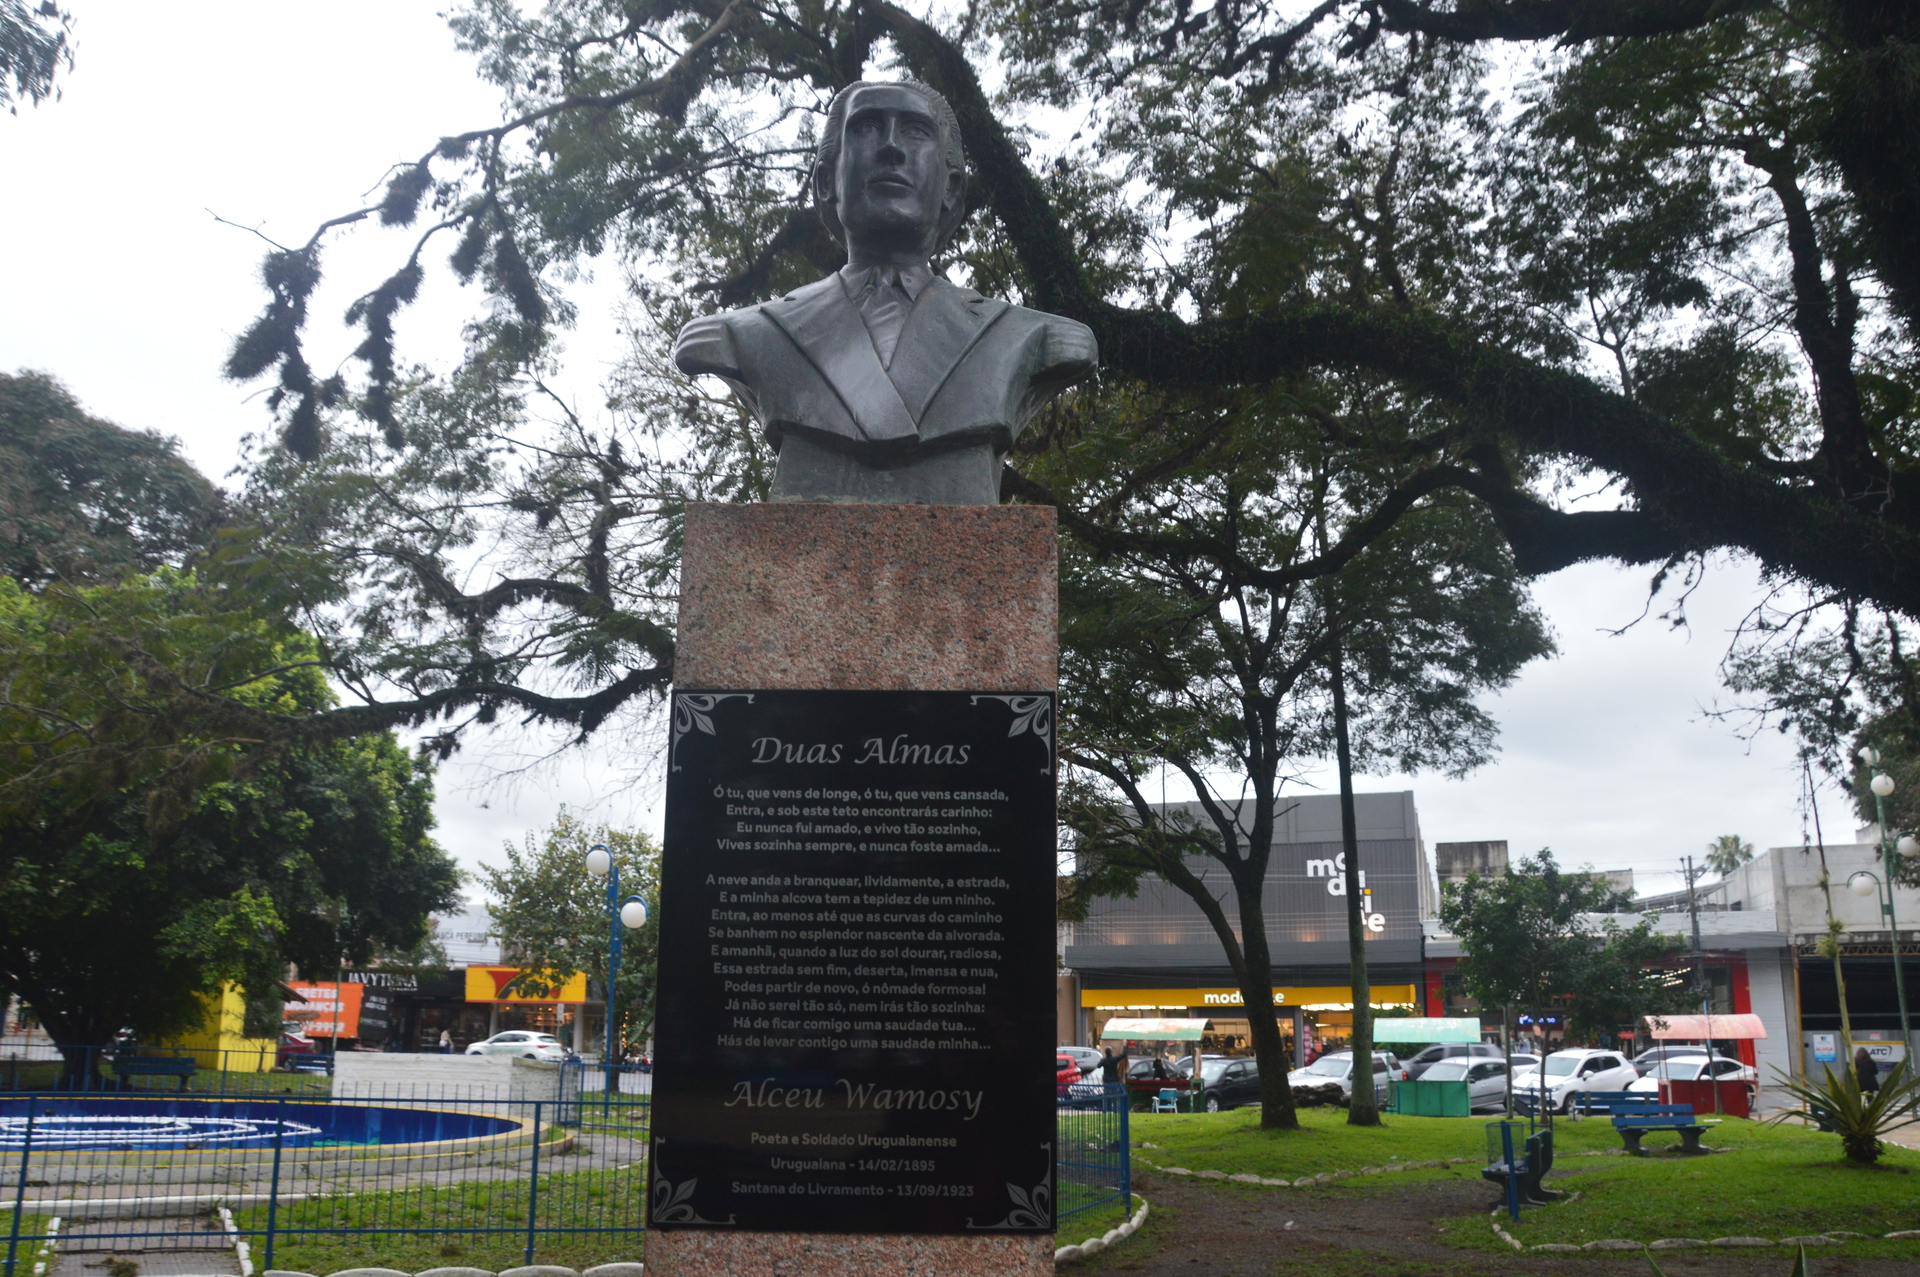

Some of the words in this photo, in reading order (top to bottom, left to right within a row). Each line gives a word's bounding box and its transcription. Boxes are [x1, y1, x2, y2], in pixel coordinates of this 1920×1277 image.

[751, 737, 843, 764] Duas
[853, 733, 971, 765] Almas
[713, 783, 724, 798] Ó
[726, 787, 744, 800] tu,
[746, 789, 770, 801] que
[771, 789, 802, 799] vens
[803, 787, 820, 799] de
[822, 787, 861, 802] longe,
[863, 787, 872, 799] ó
[873, 788, 892, 801] tu,
[894, 790, 919, 802] que
[920, 790, 951, 800] vens
[952, 788, 1009, 802] cansada,
[725, 803, 765, 817] Entra,
[766, 806, 775, 816] e
[776, 804, 800, 816] sob
[801, 805, 830, 816] este
[831, 805, 860, 817] teto
[861, 804, 939, 817] encontrarás
[940, 805, 992, 818] carinho:
[736, 821, 753, 833] Eu
[754, 823, 793, 833] nunca
[794, 821, 812, 834] fui
[813, 821, 861, 835] amado,
[863, 824, 872, 834] e
[873, 822, 901, 834] vivo
[902, 822, 925, 834] tão
[927, 822, 981, 836] sozinho,
[716, 837, 751, 850] Vives
[753, 838, 802, 851] sozinha
[804, 841, 856, 854] sempre,
[858, 842, 867, 851] e
[868, 842, 908, 852] nunca
[909, 839, 943, 852] foste
[945, 840, 1000, 853] amada...
[705, 873, 716, 885] A
[717, 875, 748, 885] neve
[749, 873, 781, 886] anda
[782, 876, 791, 886] a
[793, 874, 862, 889] branquear,
[863, 874, 944, 889] lividamente,
[946, 878, 954, 887] a
[956, 875, 1010, 889] estrada,
[719, 890, 728, 903] E
[729, 893, 737, 903] a
[739, 891, 779, 903] minha
[781, 891, 822, 904] alcova
[824, 892, 850, 904] tem
[852, 894, 860, 904] a
[862, 892, 911, 907] tepidez
[912, 892, 930, 905] de
[931, 895, 952, 905] um
[954, 893, 995, 906] ninho.
[711, 908, 750, 923] Entra,
[752, 911, 768, 921] ao
[770, 911, 814, 922] menos
[815, 909, 837, 922] até
[839, 912, 864, 925] que
[865, 912, 881, 922] as
[882, 912, 926, 923] curvas
[928, 910, 945, 923] do
[946, 910, 1003, 923] caminho
[707, 925, 724, 938] Se
[726, 926, 778, 939] banhem
[780, 929, 797, 939] no
[798, 927, 864, 943] esplendor
[865, 928, 925, 941] nascente
[926, 928, 943, 941] da
[945, 928, 1005, 941] alvorada.
[710, 943, 719, 956] E
[720, 943, 776, 958] amanhã,
[778, 945, 827, 960] quando
[828, 948, 837, 958] a
[838, 945, 858, 958] luz
[860, 945, 877, 958] do
[879, 946, 899, 958] sol
[900, 946, 947, 960] dourar,
[949, 946, 1001, 961] radiosa,
[712, 961, 743, 974] Essa
[744, 962, 794, 975] estrada
[796, 965, 824, 975] sem
[825, 963, 851, 977] fim,
[853, 963, 908, 978] deserta,
[910, 964, 957, 977] imensa
[959, 967, 968, 977] e
[969, 967, 998, 979] nua,
[724, 979, 763, 992] Podes
[765, 980, 803, 996] partir
[804, 981, 821, 993] de
[823, 984, 859, 995] novo,
[861, 981, 870, 994] ó
[872, 981, 925, 994] nômade
[926, 982, 986, 995] formosa!
[724, 997, 740, 1010] Já
[742, 998, 766, 1011] não
[768, 998, 800, 1011] serei
[802, 999, 825, 1012] tão
[826, 999, 846, 1014] só,
[848, 1002, 877, 1012] nem
[879, 999, 904, 1013] irás
[905, 1000, 929, 1013] tão
[930, 1000, 985, 1013] sozinha:
[732, 1015, 751, 1028] Há
[752, 1016, 769, 1029] de
[771, 1016, 801, 1029] ficar
[802, 1017, 851, 1033] comigo
[853, 1020, 882, 1030] uma
[884, 1018, 939, 1031] saudade
[940, 1019, 975, 1031] tua...
[717, 1033, 742, 1046] Hás
[744, 1034, 761, 1047] de
[762, 1034, 795, 1047] levar
[797, 1035, 847, 1051] contigo
[849, 1038, 878, 1049] uma
[880, 1036, 936, 1049] saudade
[937, 1036, 991, 1050] minha...
[723, 1076, 825, 1108] Alceu
[834, 1078, 983, 1121] Wamosy
[750, 1131, 789, 1145] Poeta
[790, 1135, 799, 1145] e
[801, 1132, 855, 1146] Soldado
[857, 1133, 957, 1150] Uruguaianense
[770, 1156, 846, 1173] Uruguaiana
[858, 1157, 935, 1172] 14/02/1895
[731, 1180, 786, 1194] Santana
[787, 1182, 805, 1195] do
[807, 1182, 884, 1196] Livramento
[896, 1183, 974, 1197] 13/09/1923
